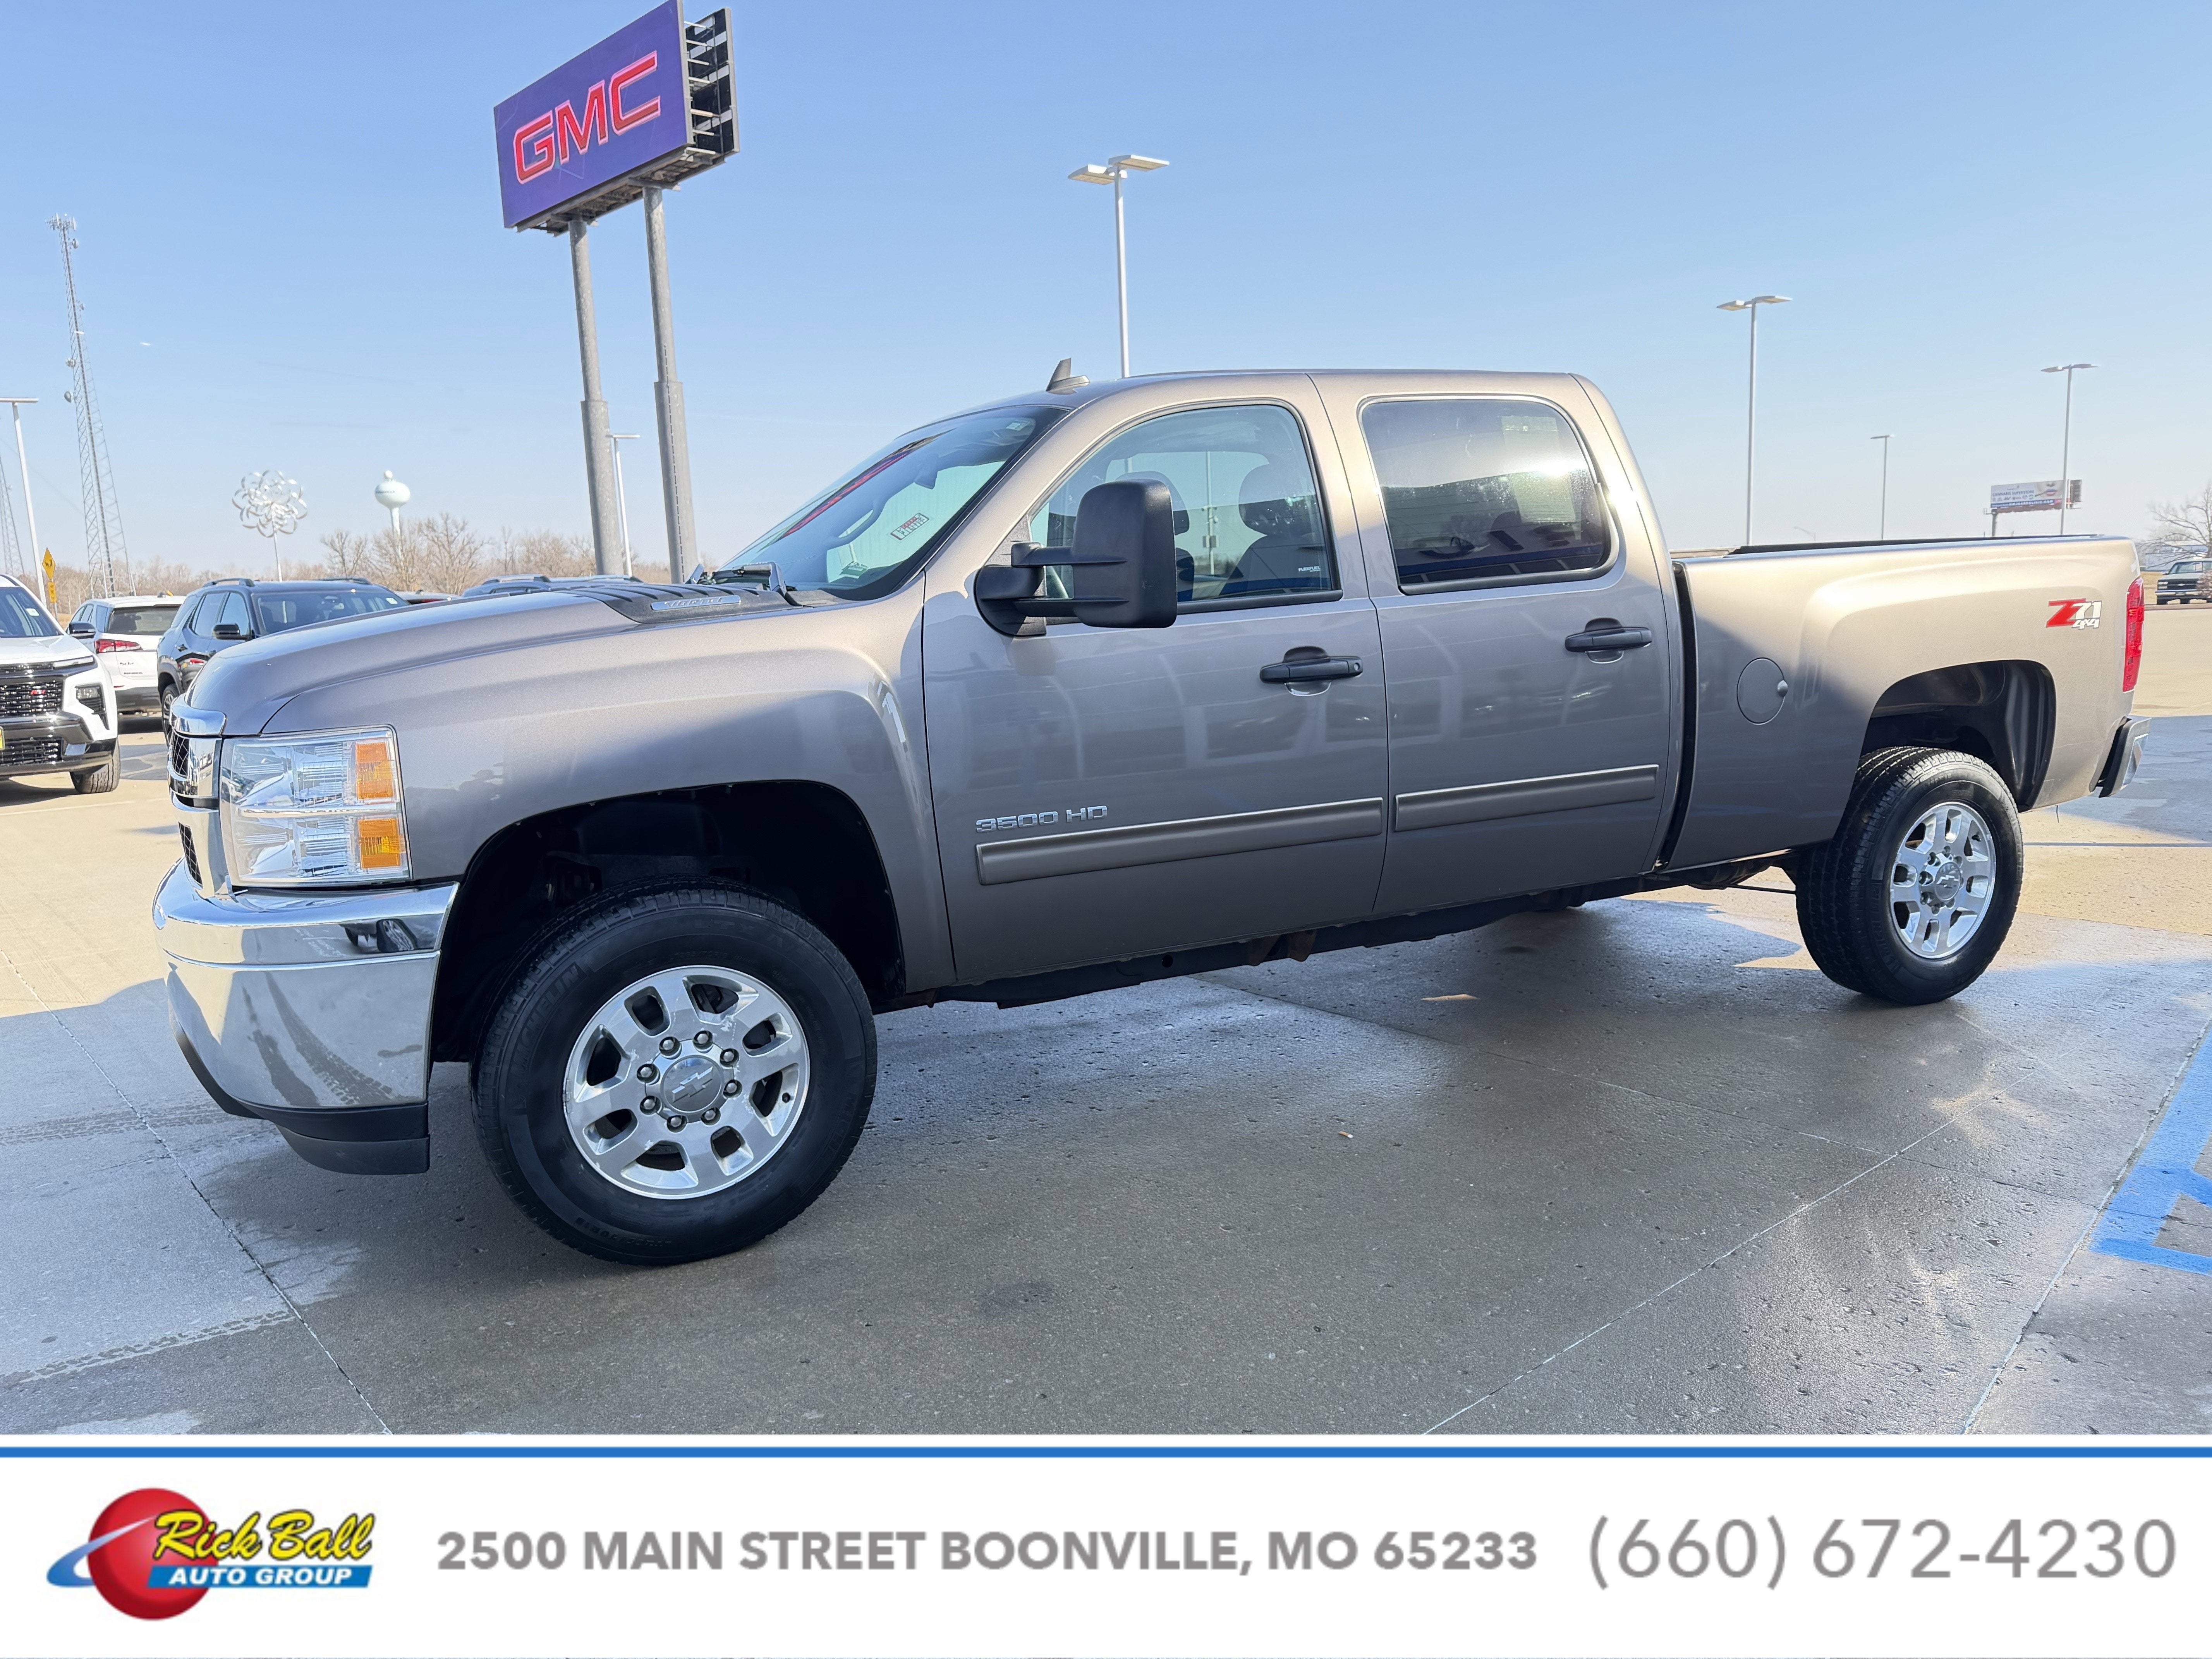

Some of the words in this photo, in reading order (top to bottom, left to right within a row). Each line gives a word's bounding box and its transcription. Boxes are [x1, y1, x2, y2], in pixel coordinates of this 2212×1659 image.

[513, 50, 661, 185] GMC
[2046, 598, 2102, 628] Z71
[976, 811, 1058, 833] 3500
[1066, 805, 1108, 823] HD
[511, 965, 580, 1074] MICHELIN
